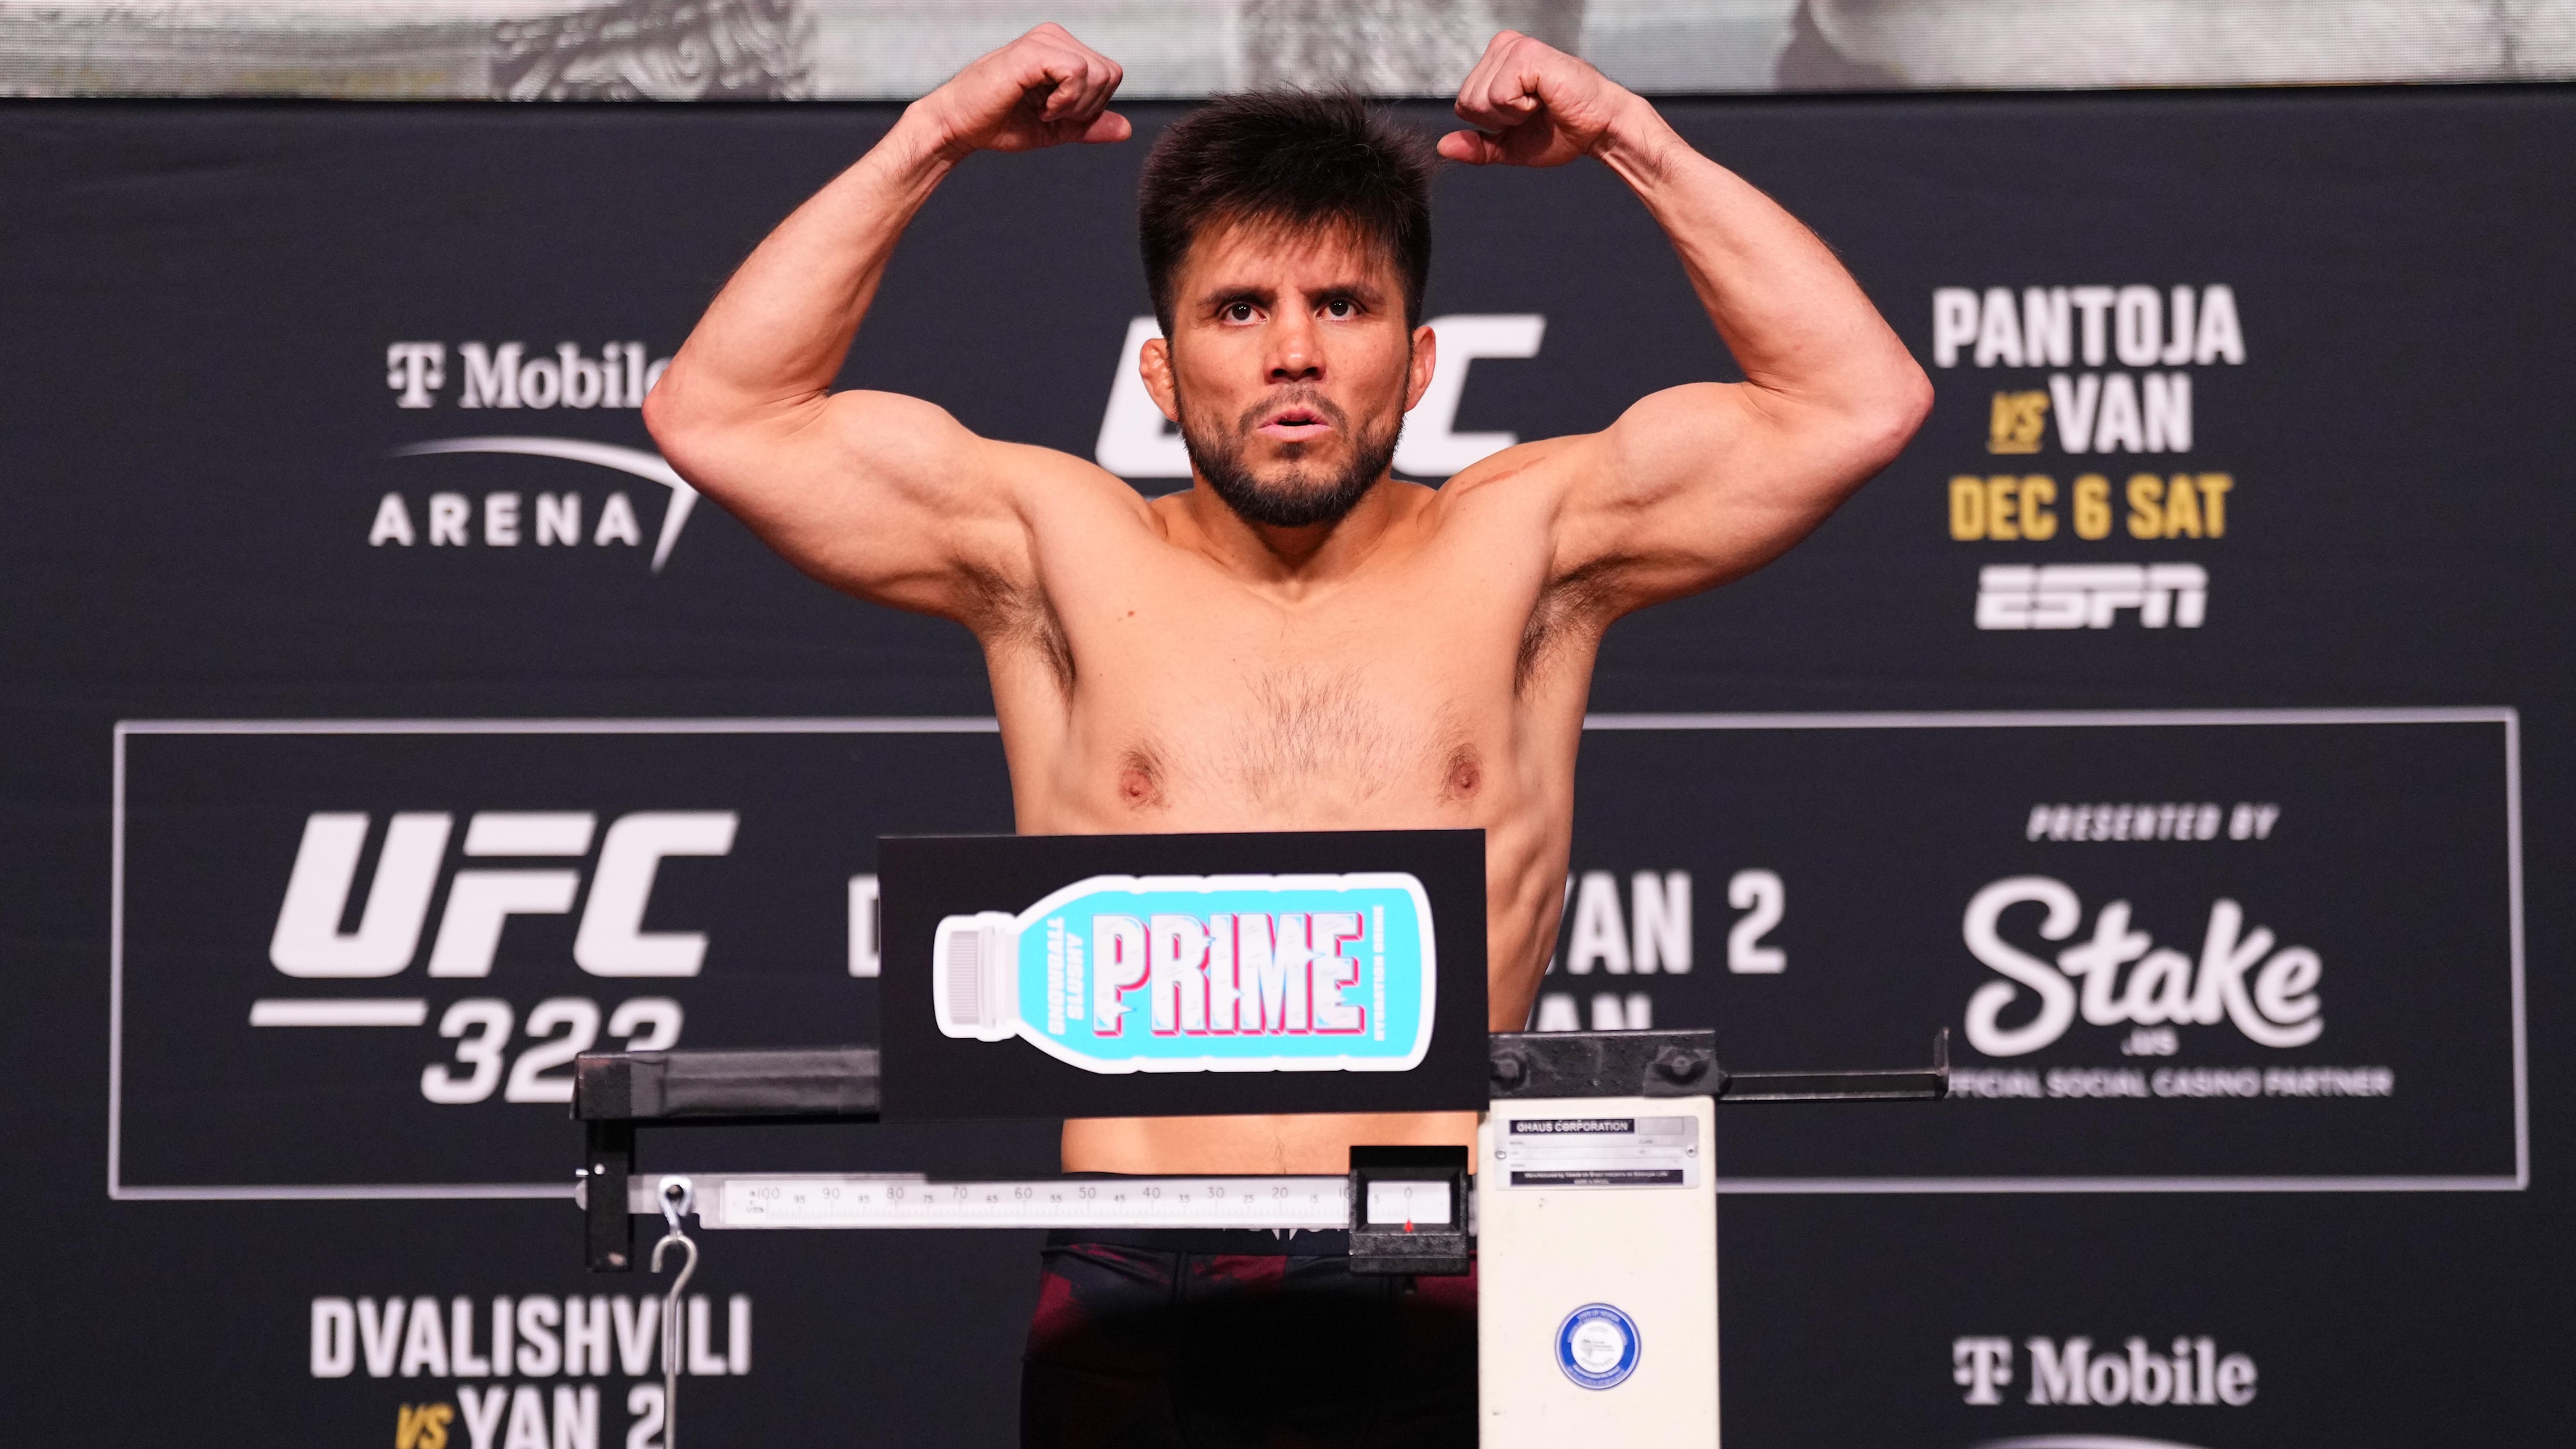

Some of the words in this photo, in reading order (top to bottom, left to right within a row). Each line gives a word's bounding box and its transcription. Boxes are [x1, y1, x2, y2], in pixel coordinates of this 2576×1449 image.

[1933, 284, 2245, 368] PANTOJA
[1989, 391, 2048, 454] VS
[2048, 372, 2192, 454] VAN
[369, 492, 641, 546] ARENA
[1948, 475, 2057, 541] DEC
[2073, 474, 2112, 540] 6
[2126, 473, 2233, 539] SAT
[1975, 563, 2208, 629] ESPN
[2027, 803, 2222, 841] PRESENTED
[2228, 803, 2279, 841] BY
[269, 811, 739, 978] UFC
[1545, 871, 1693, 975] AN
[1727, 869, 1786, 974] 2
[1047, 916, 1066, 1036] SNOWBALL
[1067, 932, 1085, 1021] SLUSHY
[1091, 911, 1366, 1037] PRIME
[1962, 875, 2324, 1056] Stake
[2046, 1069, 2148, 1098] SOCIAL
[2151, 1068, 2262, 1098] CASINO
[2264, 1067, 2394, 1097] PARTNER
[1554, 1121, 1628, 1132] CORPORATION
[822, 1187, 840, 1200] 90
[887, 1187, 904, 1200] 80
[953, 1187, 968, 1200] 70
[1014, 1187, 1033, 1200] 60
[1078, 1187, 1096, 1200] 50
[1143, 1187, 1160, 1199] 40
[1206, 1187, 1224, 1199] 30
[1272, 1187, 1288, 1199] 20
[1404, 1187, 1412, 1200] 0
[922, 1195, 934, 1203] 75
[310, 1294, 751, 1377] DVALISHVILI
[1952, 1337, 2013, 1405] T
[2026, 1337, 2257, 1406] Mobile
[396, 1403, 454, 1449] VS
[457, 1385, 600, 1449] YAN
[626, 1383, 665, 1449] 2
